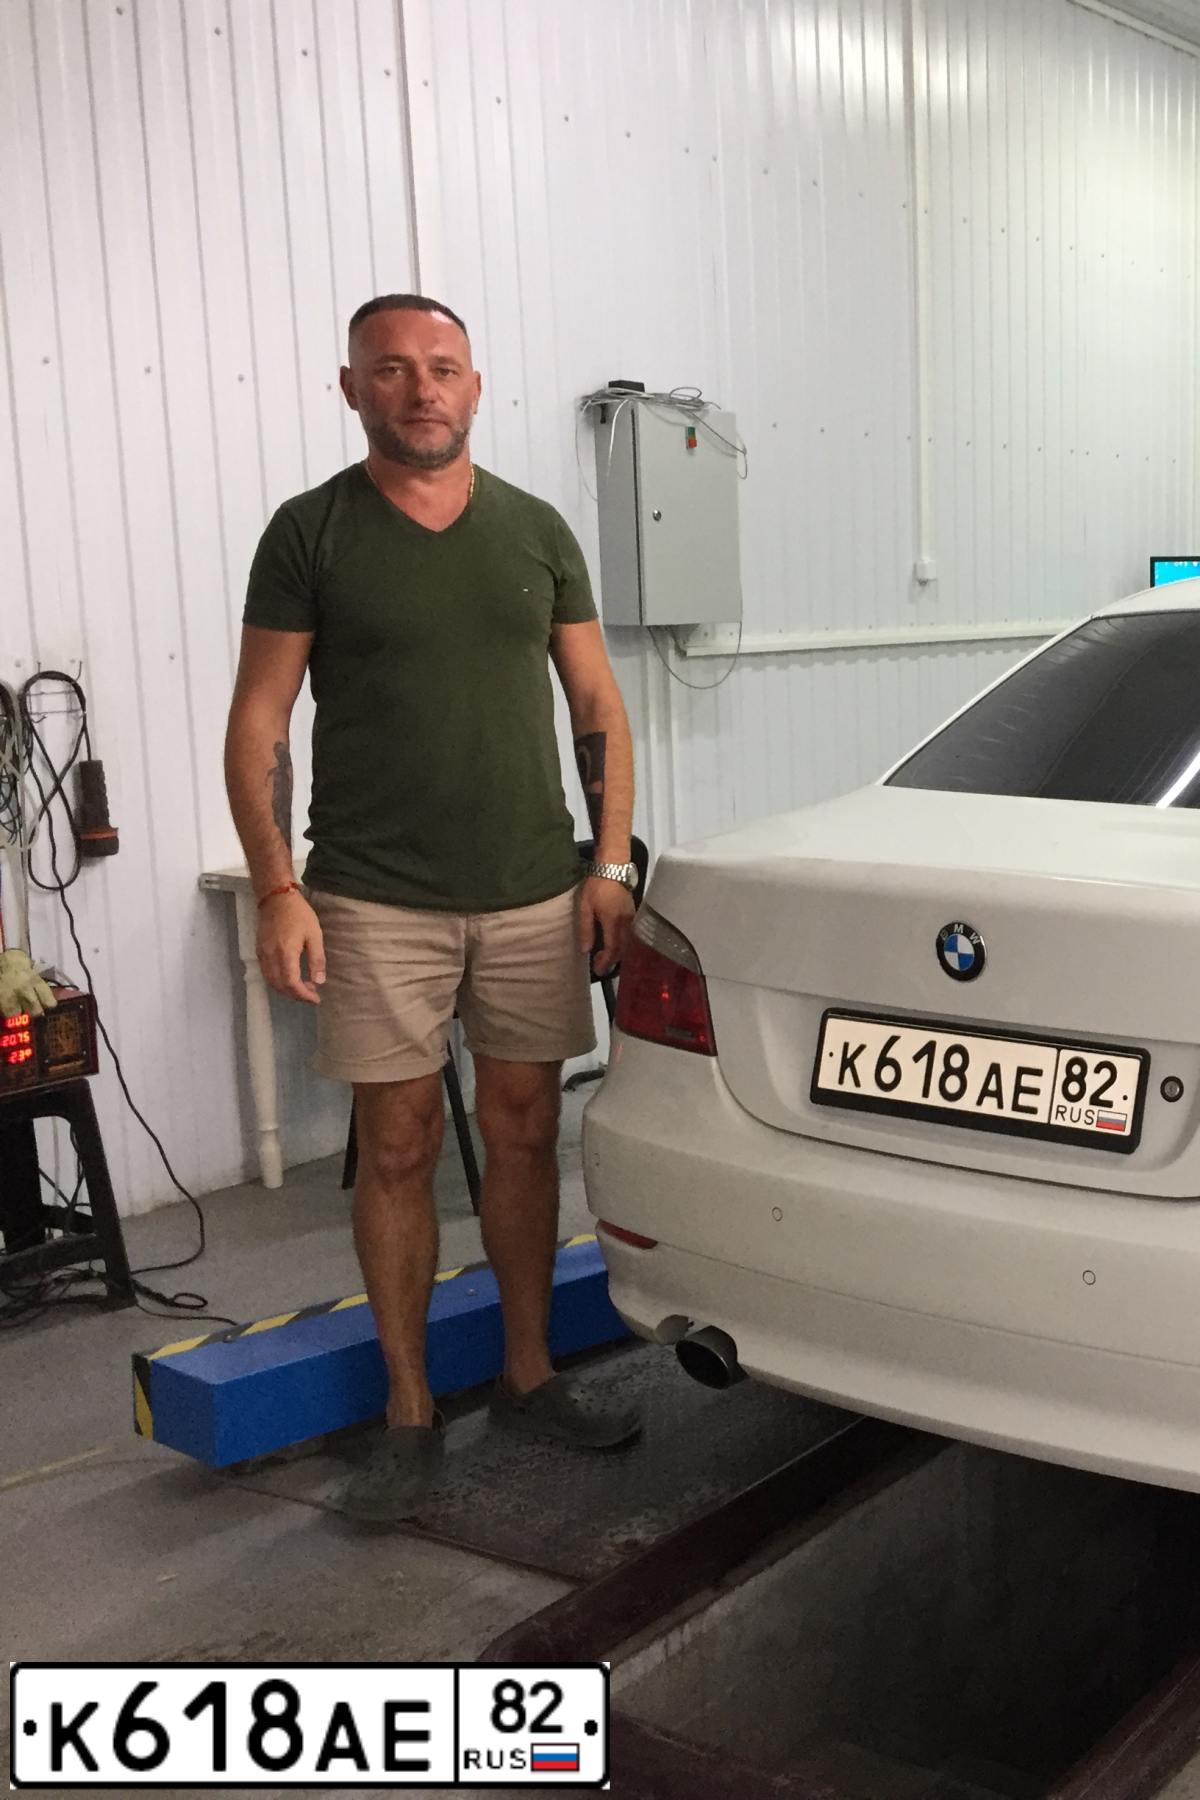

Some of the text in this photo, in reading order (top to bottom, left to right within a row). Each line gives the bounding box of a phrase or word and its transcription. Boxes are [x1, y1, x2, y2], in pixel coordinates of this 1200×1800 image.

[940, 923, 981, 945] BMW
[1061, 1056, 1118, 1109] 82
[1055, 1104, 1095, 1126] RUS
